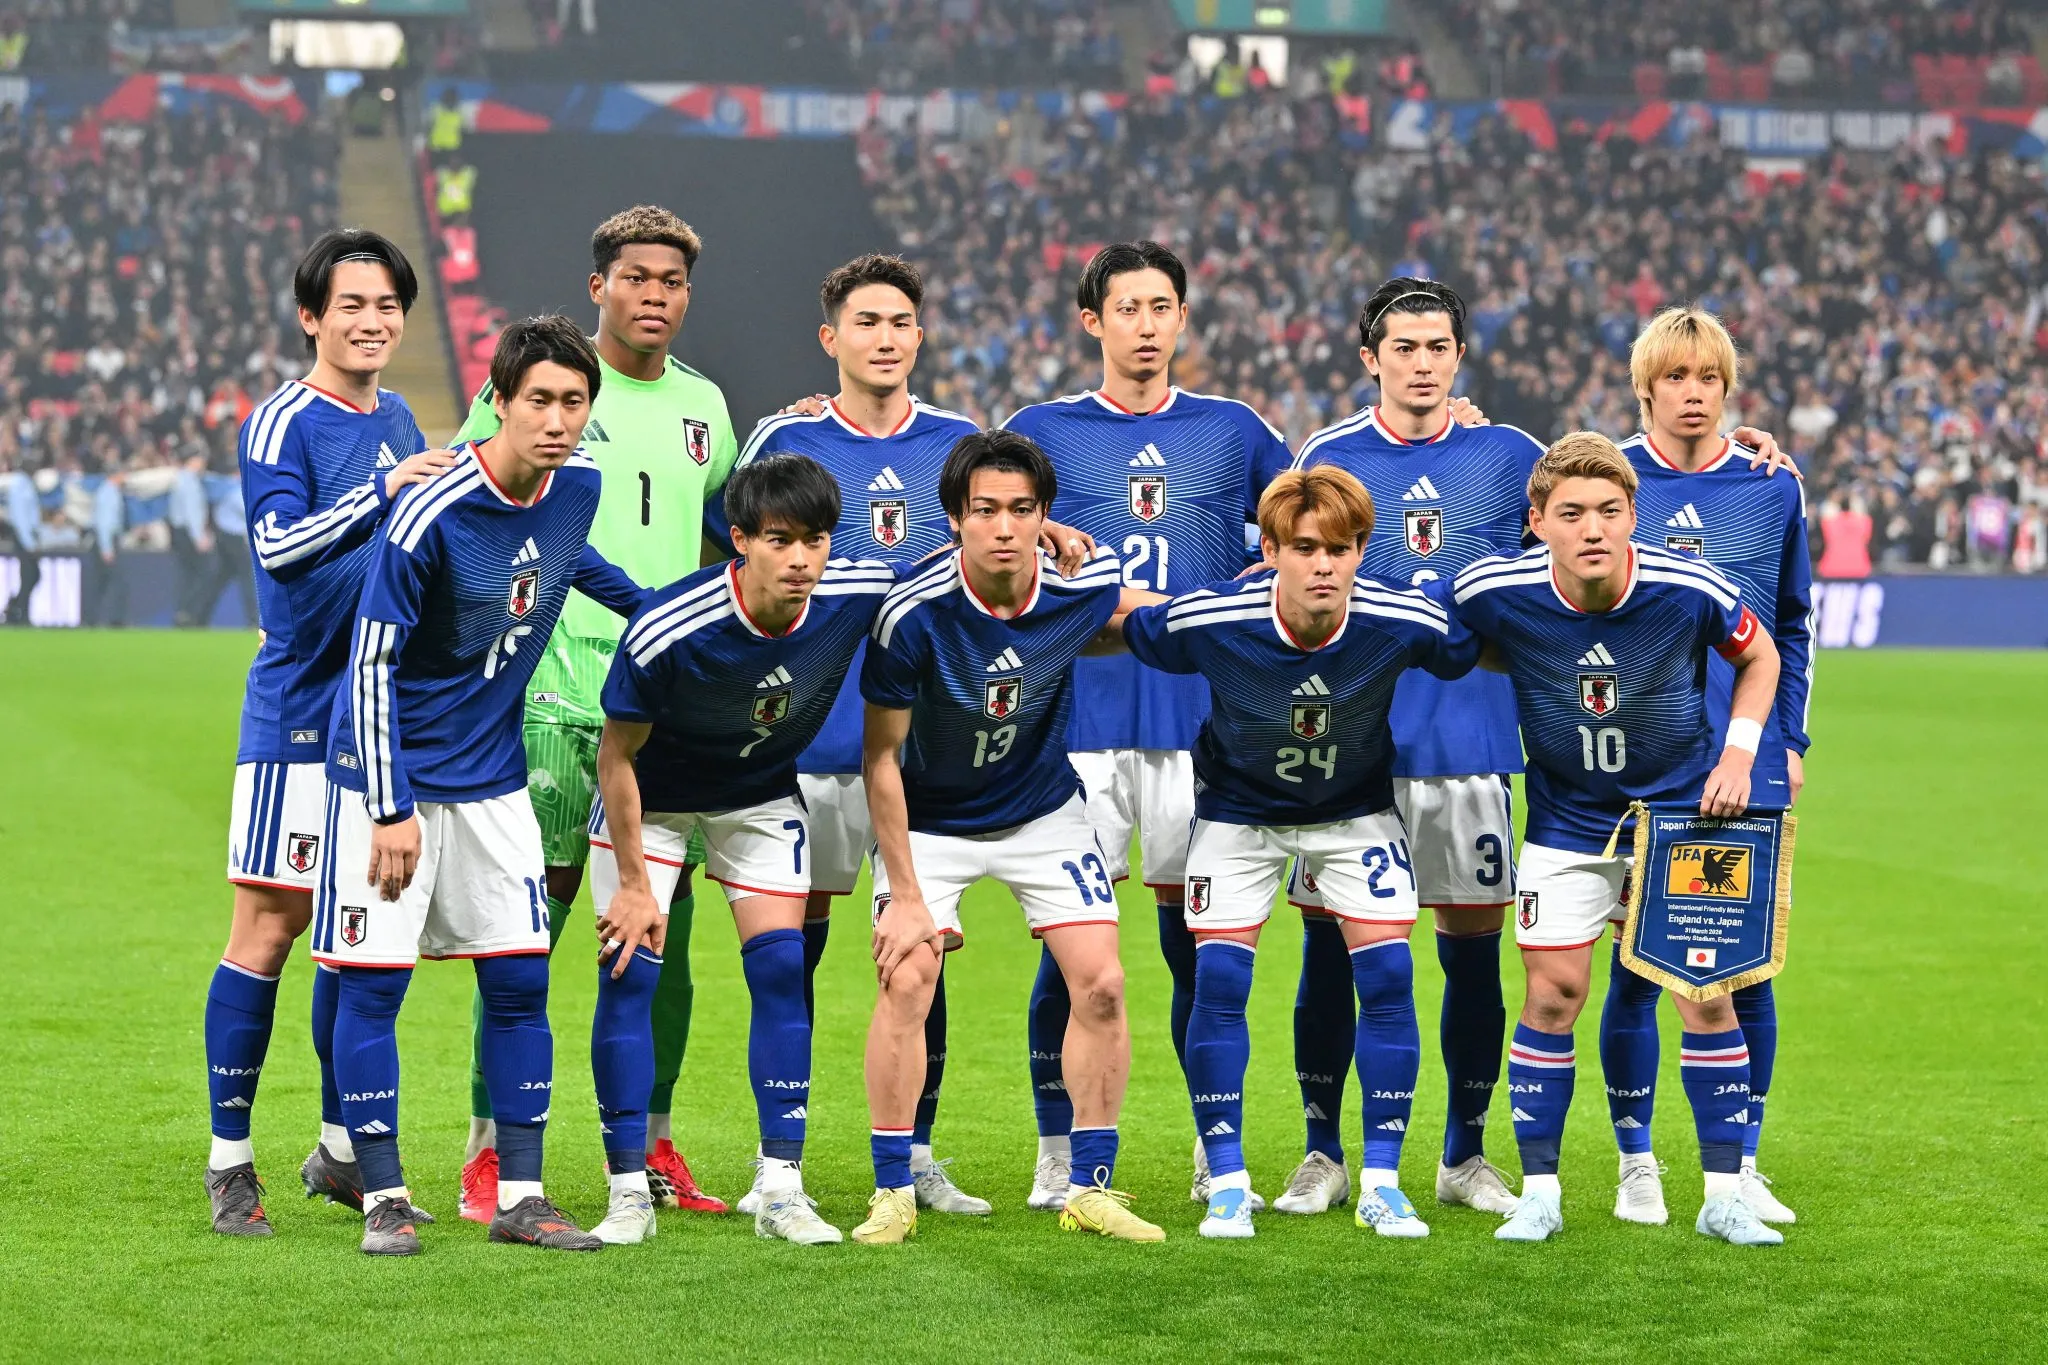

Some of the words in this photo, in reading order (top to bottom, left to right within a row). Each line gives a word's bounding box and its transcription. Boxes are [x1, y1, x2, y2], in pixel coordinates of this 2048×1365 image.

[638, 471, 651, 526] 1
[1139, 507, 1156, 515] JFA
[880, 534, 898, 542] JFA
[1416, 542, 1433, 550] JFA
[1122, 535, 1169, 590] 21
[1591, 702, 1608, 710] JFA
[739, 726, 773, 758] 7
[973, 724, 1018, 768] 13
[1577, 725, 1627, 773] 10
[1276, 745, 1338, 783] 24
[1659, 821, 1684, 831] Japan
[1685, 820, 1719, 829] Football
[1720, 820, 1771, 833] Association
[783, 819, 806, 875] 7
[1475, 833, 1503, 887] 3
[1672, 848, 1702, 861] JFA
[1361, 838, 1416, 899] 24
[1062, 853, 1113, 906] 13
[1667, 904, 1703, 912] International
[1703, 905, 1726, 914] Friendly
[1668, 914, 1702, 926] England
[1703, 917, 1716, 925] vs.
[1716, 917, 1743, 928] Japan
[1718, 937, 1740, 945] England
[1031, 1050, 1062, 1061] JAP
[518, 1081, 553, 1090] JAP
[763, 1079, 811, 1090] JAPA
[1508, 1083, 1543, 1094] PAN
[1713, 1083, 1751, 1096] JAP
[342, 1088, 395, 1102] JAPAN
[1194, 1092, 1240, 1103] JAPAN
[1371, 1090, 1415, 1100] JAPA
